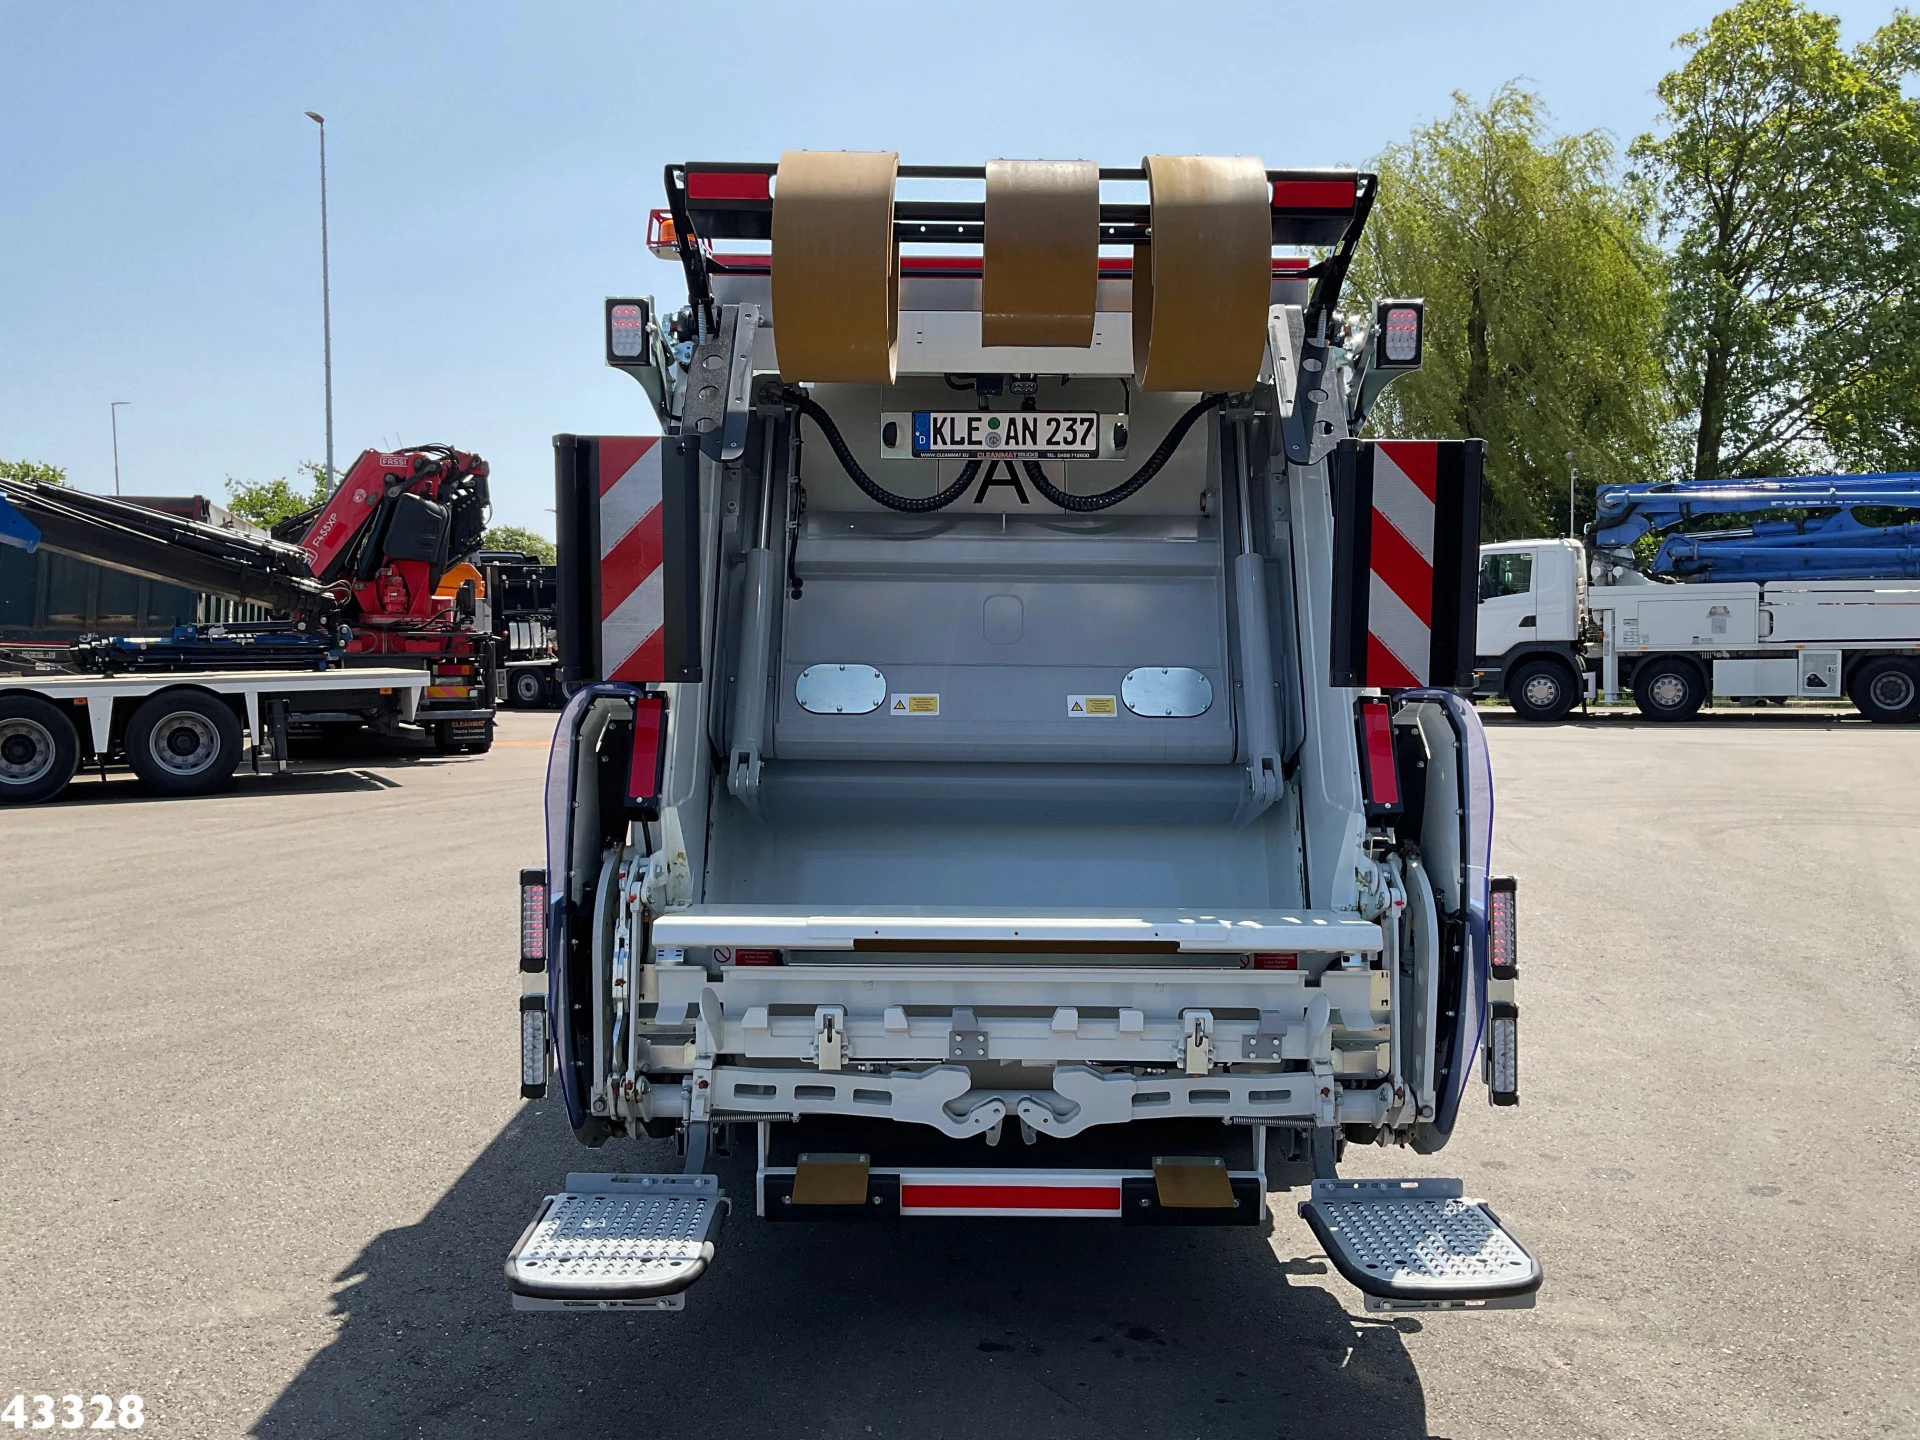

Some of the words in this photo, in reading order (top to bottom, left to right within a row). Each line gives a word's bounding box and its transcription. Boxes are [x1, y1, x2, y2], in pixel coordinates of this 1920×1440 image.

[919, 435, 926, 444] D
[932, 416, 983, 446] KLE
[1004, 417, 1038, 446] AN
[1046, 417, 1095, 446] 237
[382, 458, 407, 466] FASSI
[973, 459, 1030, 504] A
[312, 512, 337, 547] F455XP
